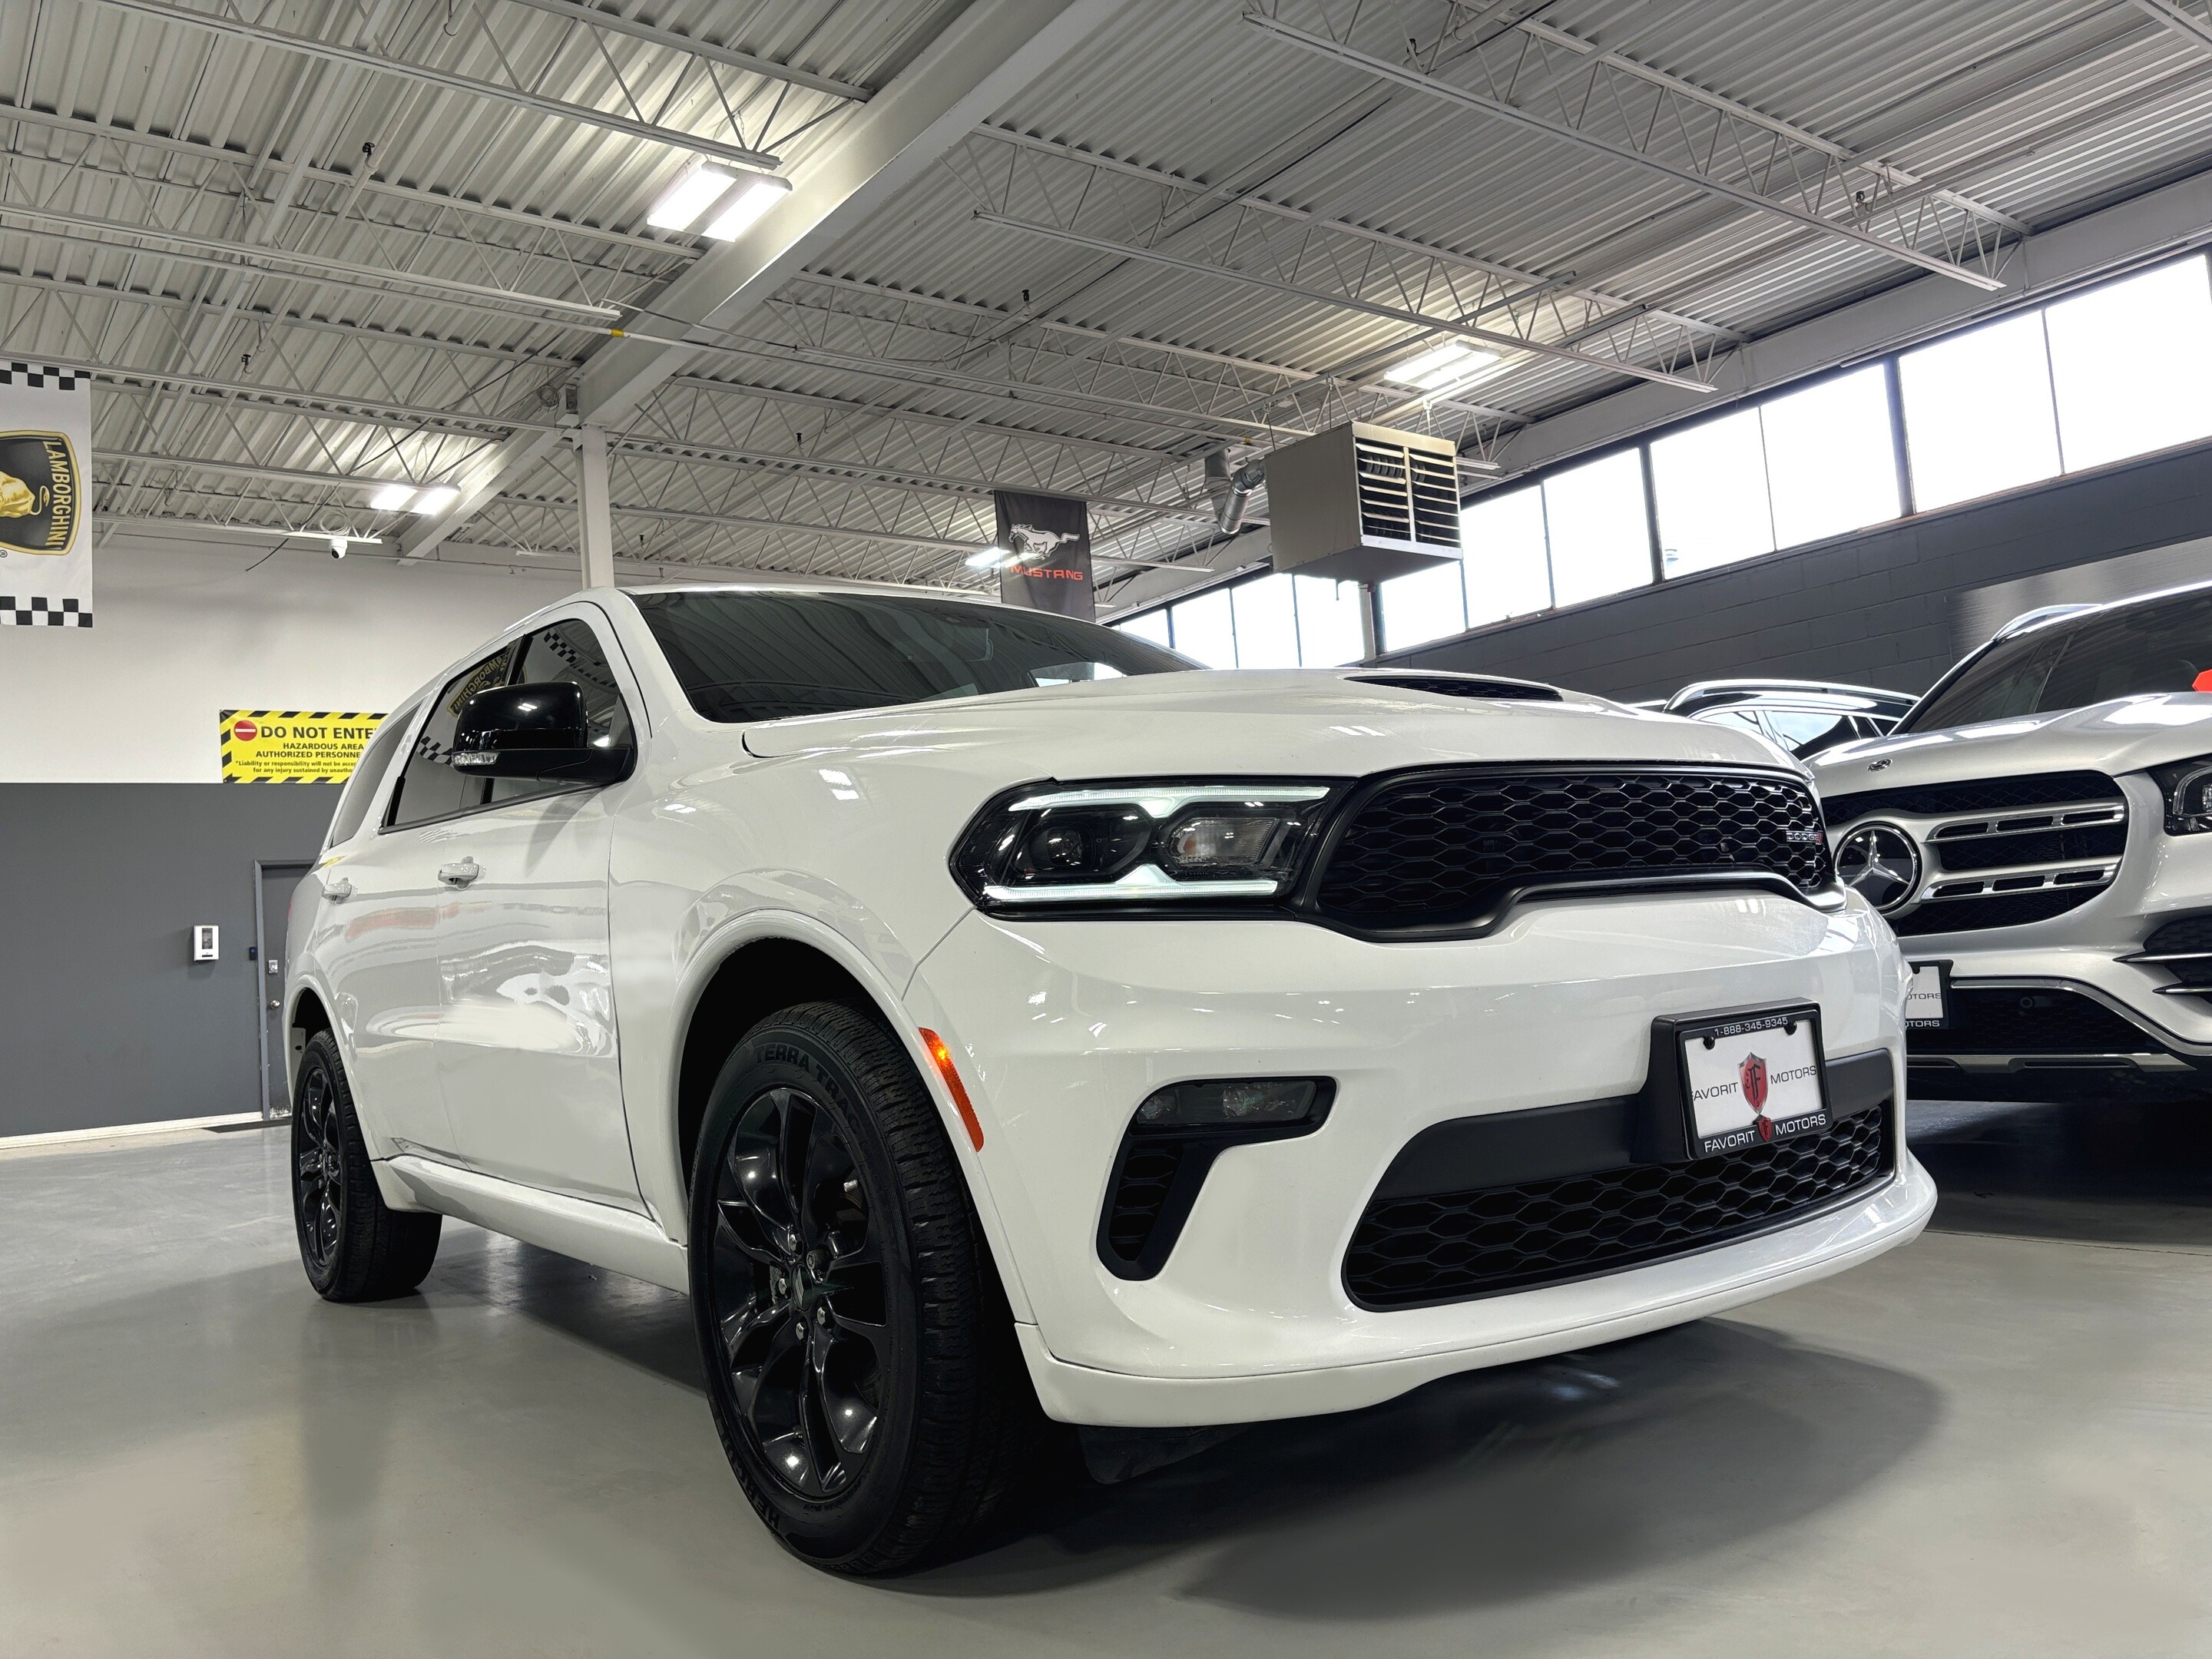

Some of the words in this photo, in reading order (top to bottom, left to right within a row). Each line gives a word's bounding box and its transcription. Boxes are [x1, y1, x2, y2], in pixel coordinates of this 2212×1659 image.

[42, 440, 72, 546] LAMBORGHINI
[1010, 565, 1084, 581] MUSTANG
[261, 726, 286, 738] DO
[293, 727, 327, 738] NOT
[333, 727, 376, 739] ENTE
[1714, 1017, 1788, 1036] 1-888-345-9345
[753, 1043, 810, 1072] TERRA
[1770, 1065, 1817, 1084] MOTORS
[1704, 1131, 1755, 1153] FAVORIT
[1775, 1114, 1826, 1135] MOTORS
